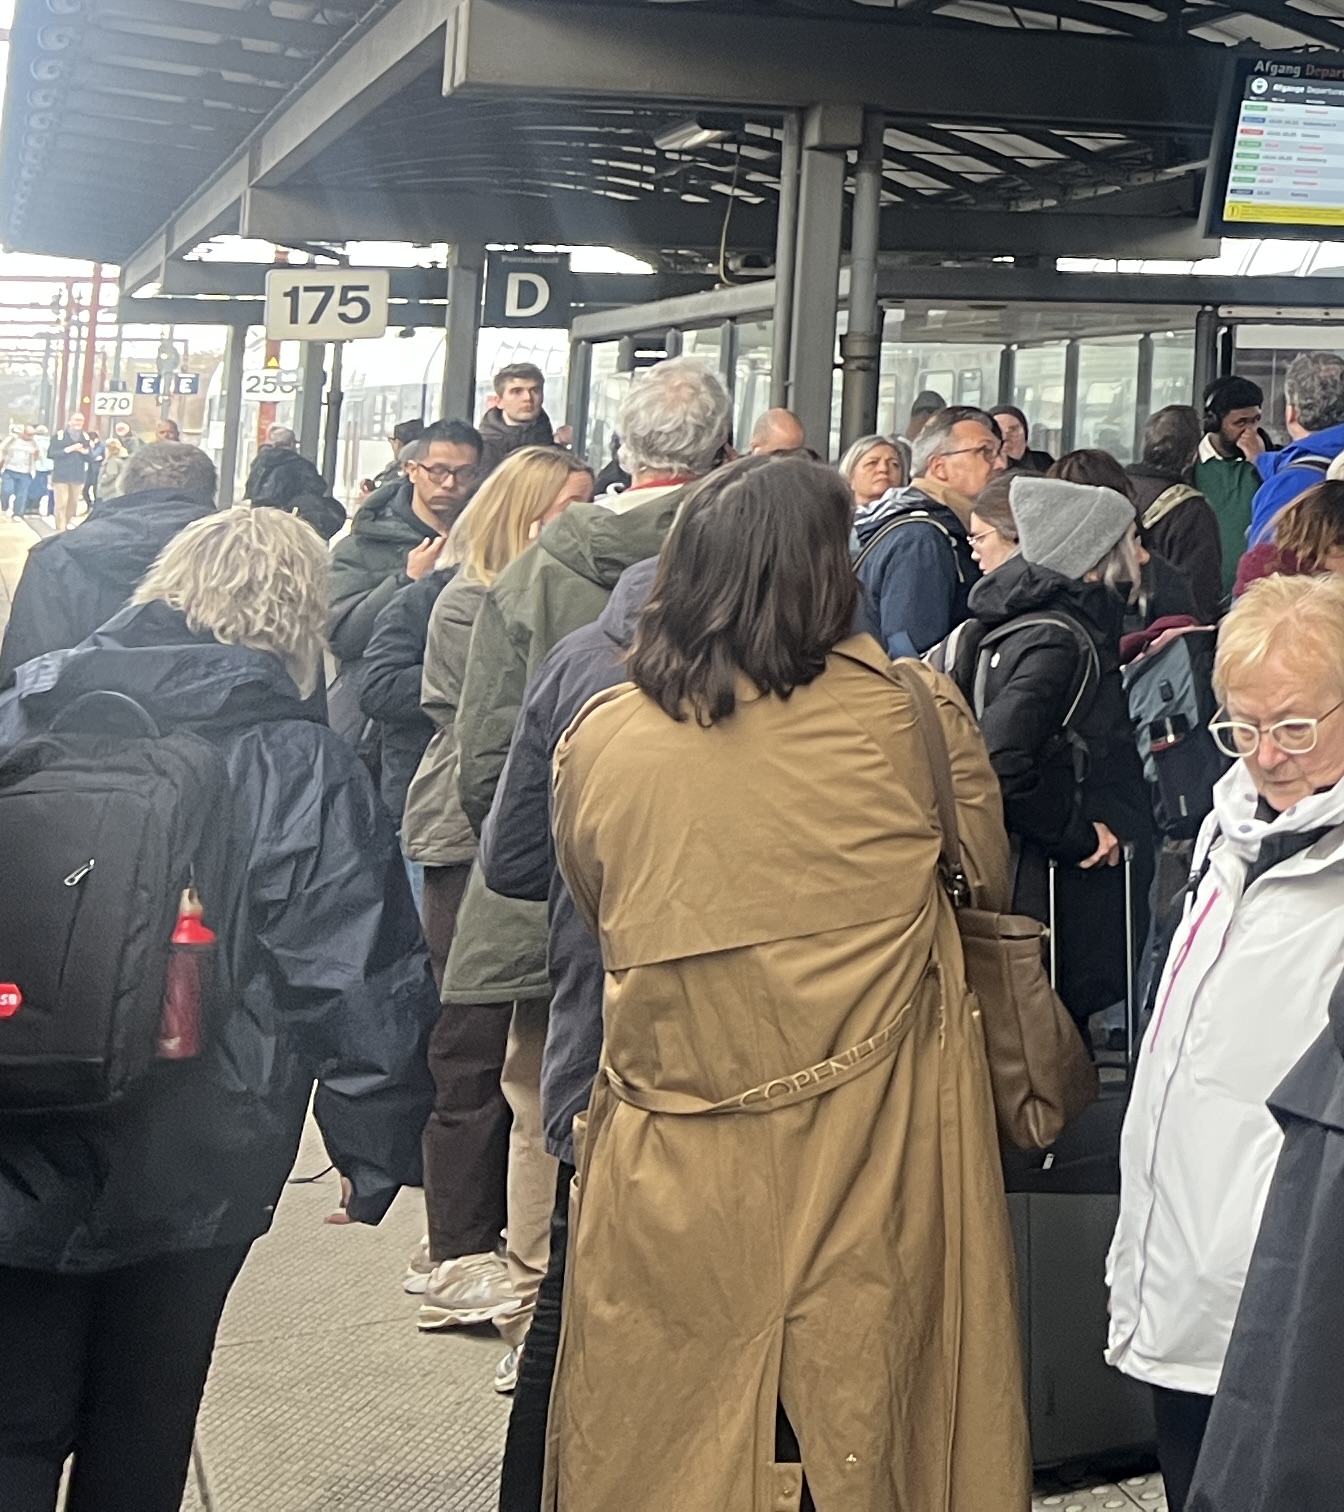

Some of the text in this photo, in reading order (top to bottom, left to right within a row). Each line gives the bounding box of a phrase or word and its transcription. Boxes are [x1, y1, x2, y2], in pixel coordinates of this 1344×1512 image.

[1254, 59, 1302, 78] Afgang
[505, 272, 550, 318] D
[283, 284, 371, 325] 175
[141, 377, 154, 394] E
[178, 377, 193, 394] E
[97, 396, 130, 410] 270
